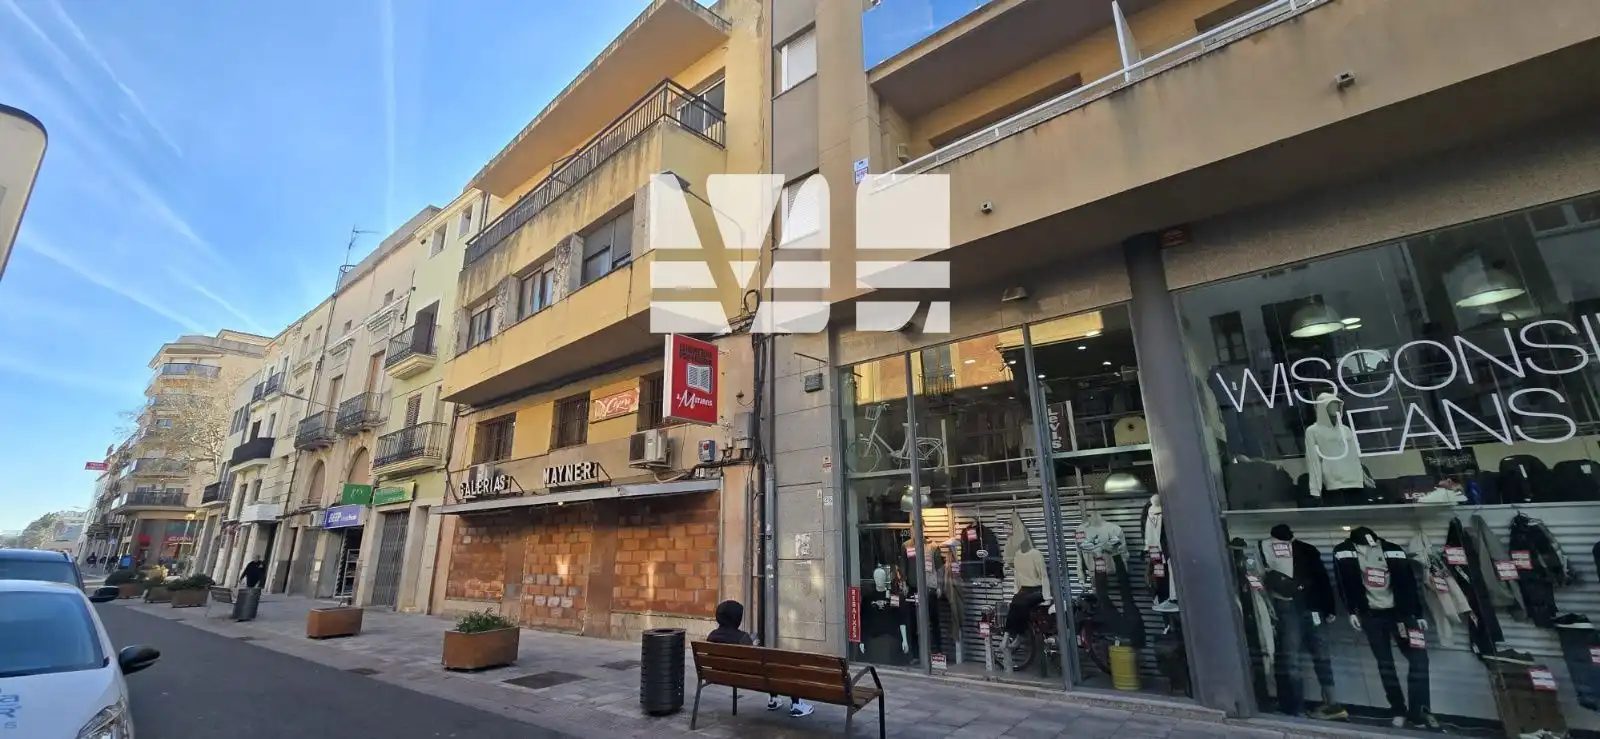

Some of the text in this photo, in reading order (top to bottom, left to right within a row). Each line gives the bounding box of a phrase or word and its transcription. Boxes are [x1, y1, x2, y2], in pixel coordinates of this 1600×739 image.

[1215, 313, 1600, 413] WISCONSI
[1314, 387, 1577, 460] JEANS
[459, 462, 595, 497] GALERIAS MAYNER
